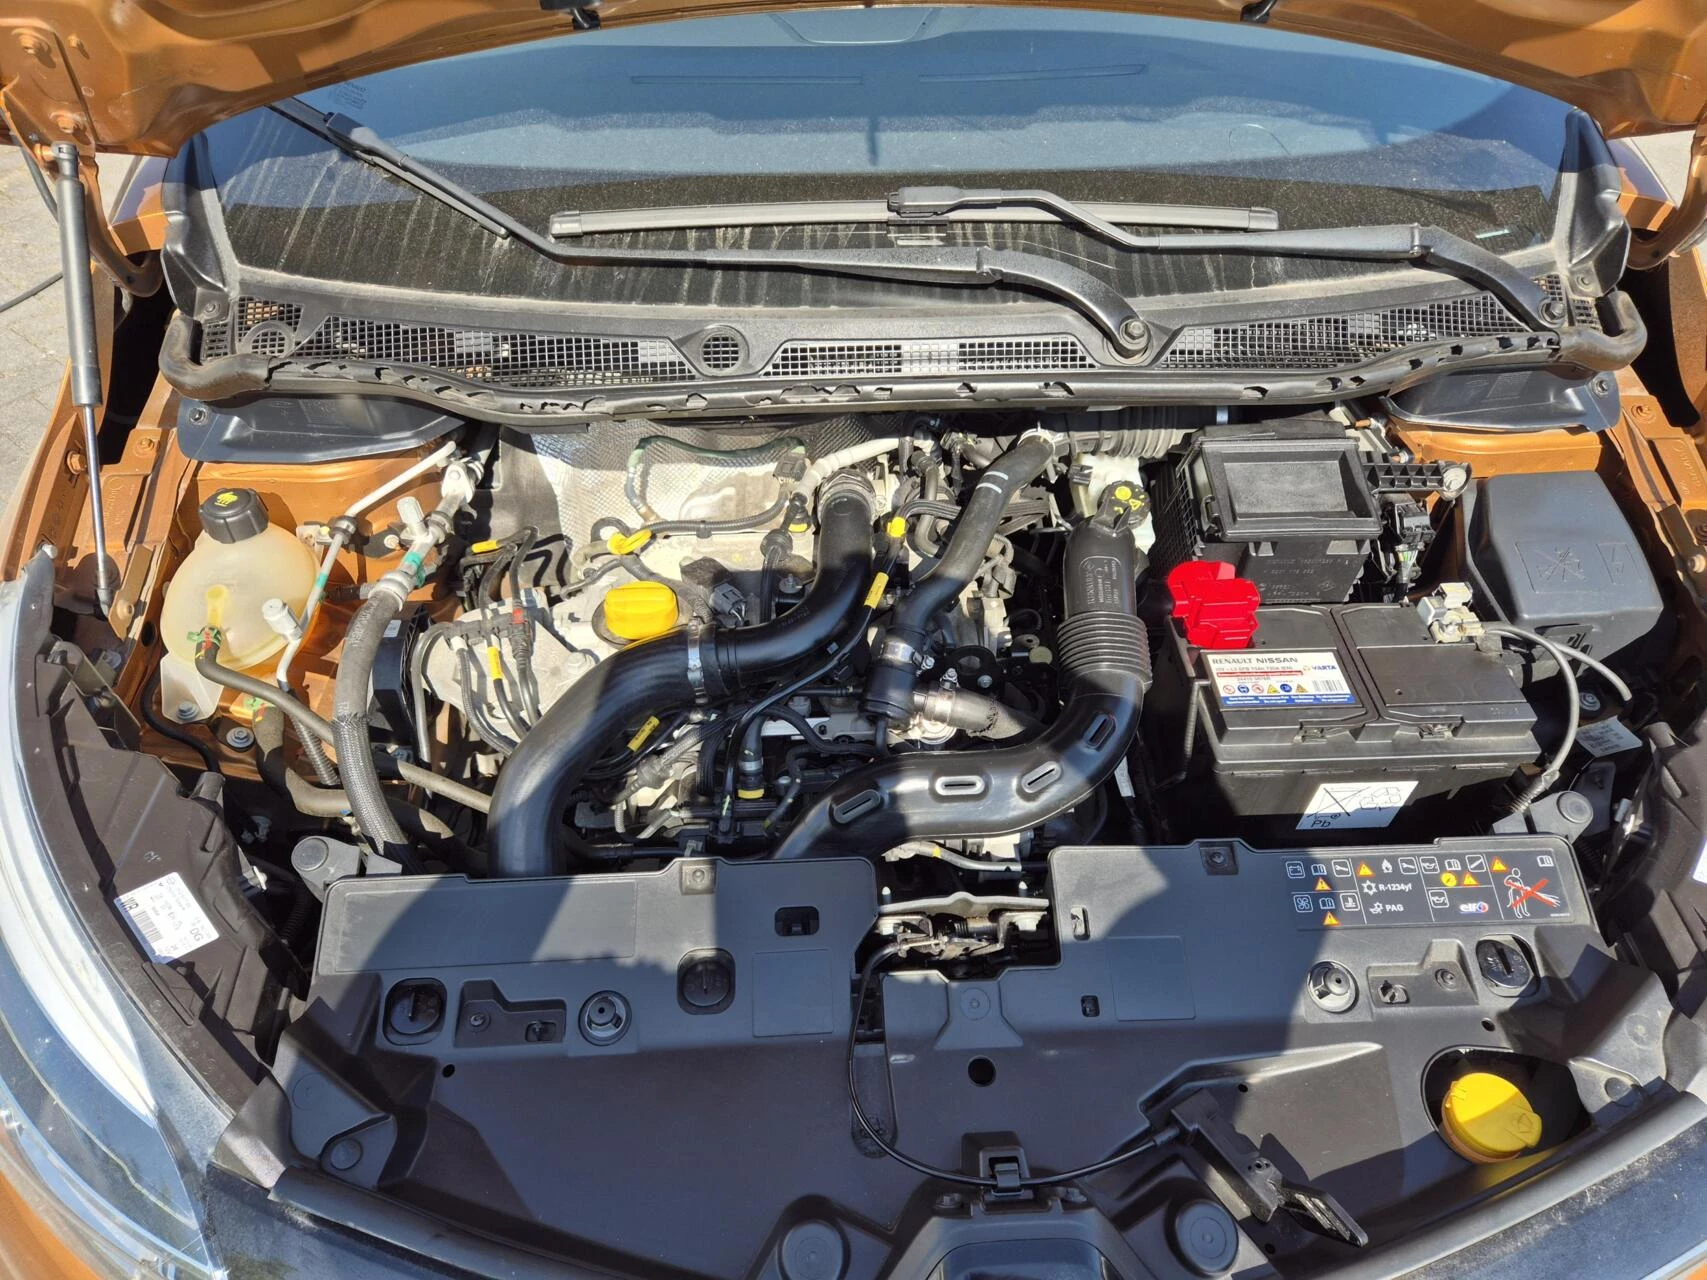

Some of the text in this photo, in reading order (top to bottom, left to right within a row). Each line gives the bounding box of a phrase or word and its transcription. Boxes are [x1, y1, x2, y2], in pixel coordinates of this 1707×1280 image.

[1311, 820, 1331, 828] Pb
[1378, 883, 1412, 892] R-1234yf
[1385, 904, 1404, 912] PAG
[1459, 903, 1479, 912] elf
